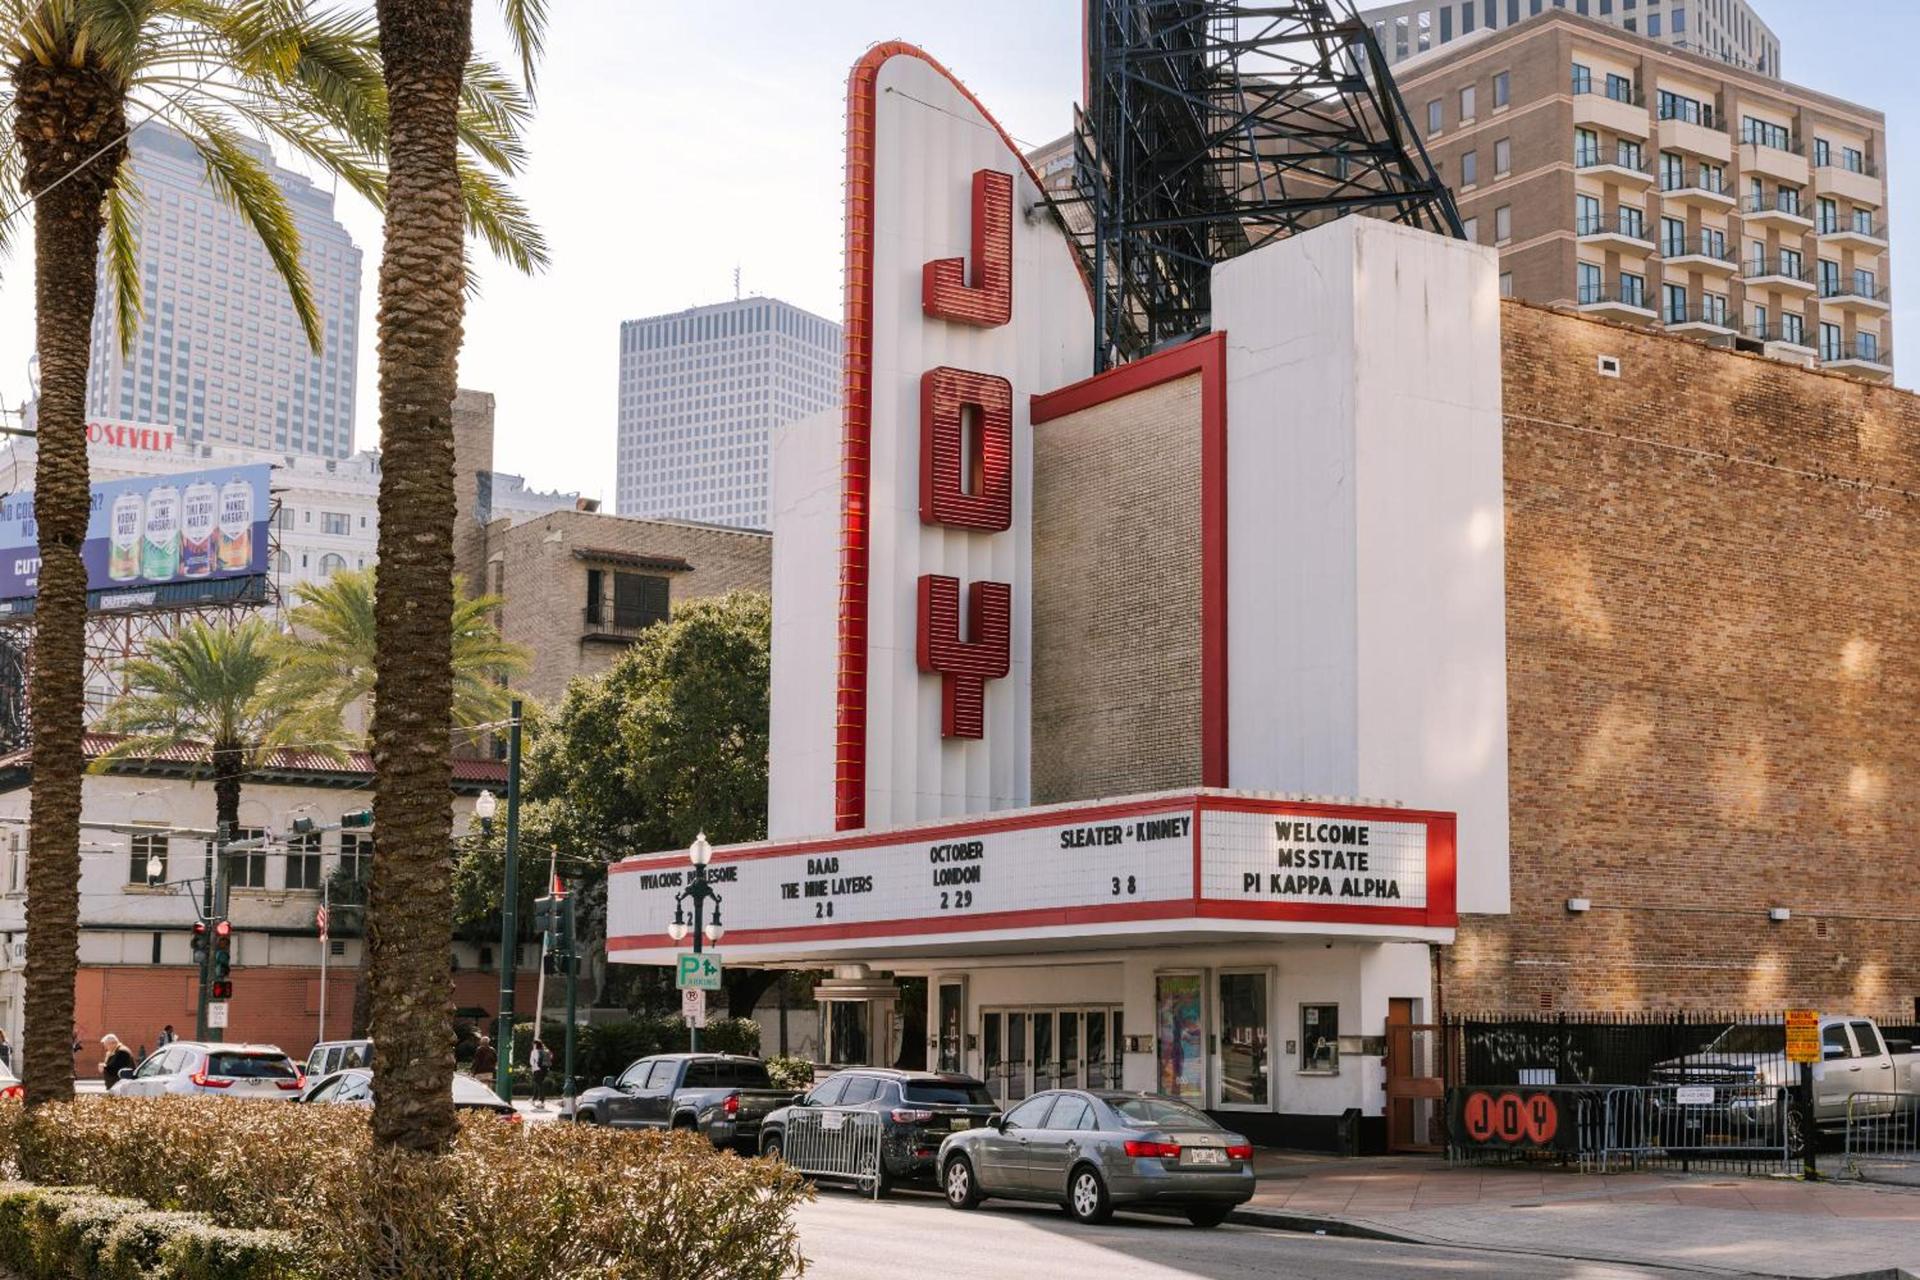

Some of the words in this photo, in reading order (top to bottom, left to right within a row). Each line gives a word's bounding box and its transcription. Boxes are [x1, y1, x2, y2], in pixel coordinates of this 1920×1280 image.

[917, 168, 1013, 740] JOY
[1274, 821, 1369, 846] WELCOME
[930, 840, 984, 864] OCTOBER
[807, 857, 839, 876] BAAB
[933, 865, 981, 887] LONDON
[780, 882, 800, 900] THE
[804, 880, 828, 898] NINE
[831, 875, 873, 896] LAYERS
[1111, 876, 1120, 896] 3
[1127, 875, 1136, 895] 8
[1243, 873, 1261, 893] PI
[1270, 873, 1333, 896] KAPPA
[1339, 877, 1400, 899] ALPHA
[816, 902, 823, 919] 2
[940, 891, 949, 910] 2
[955, 889, 973, 909] 29
[1474, 1099, 1547, 1136] JOY
